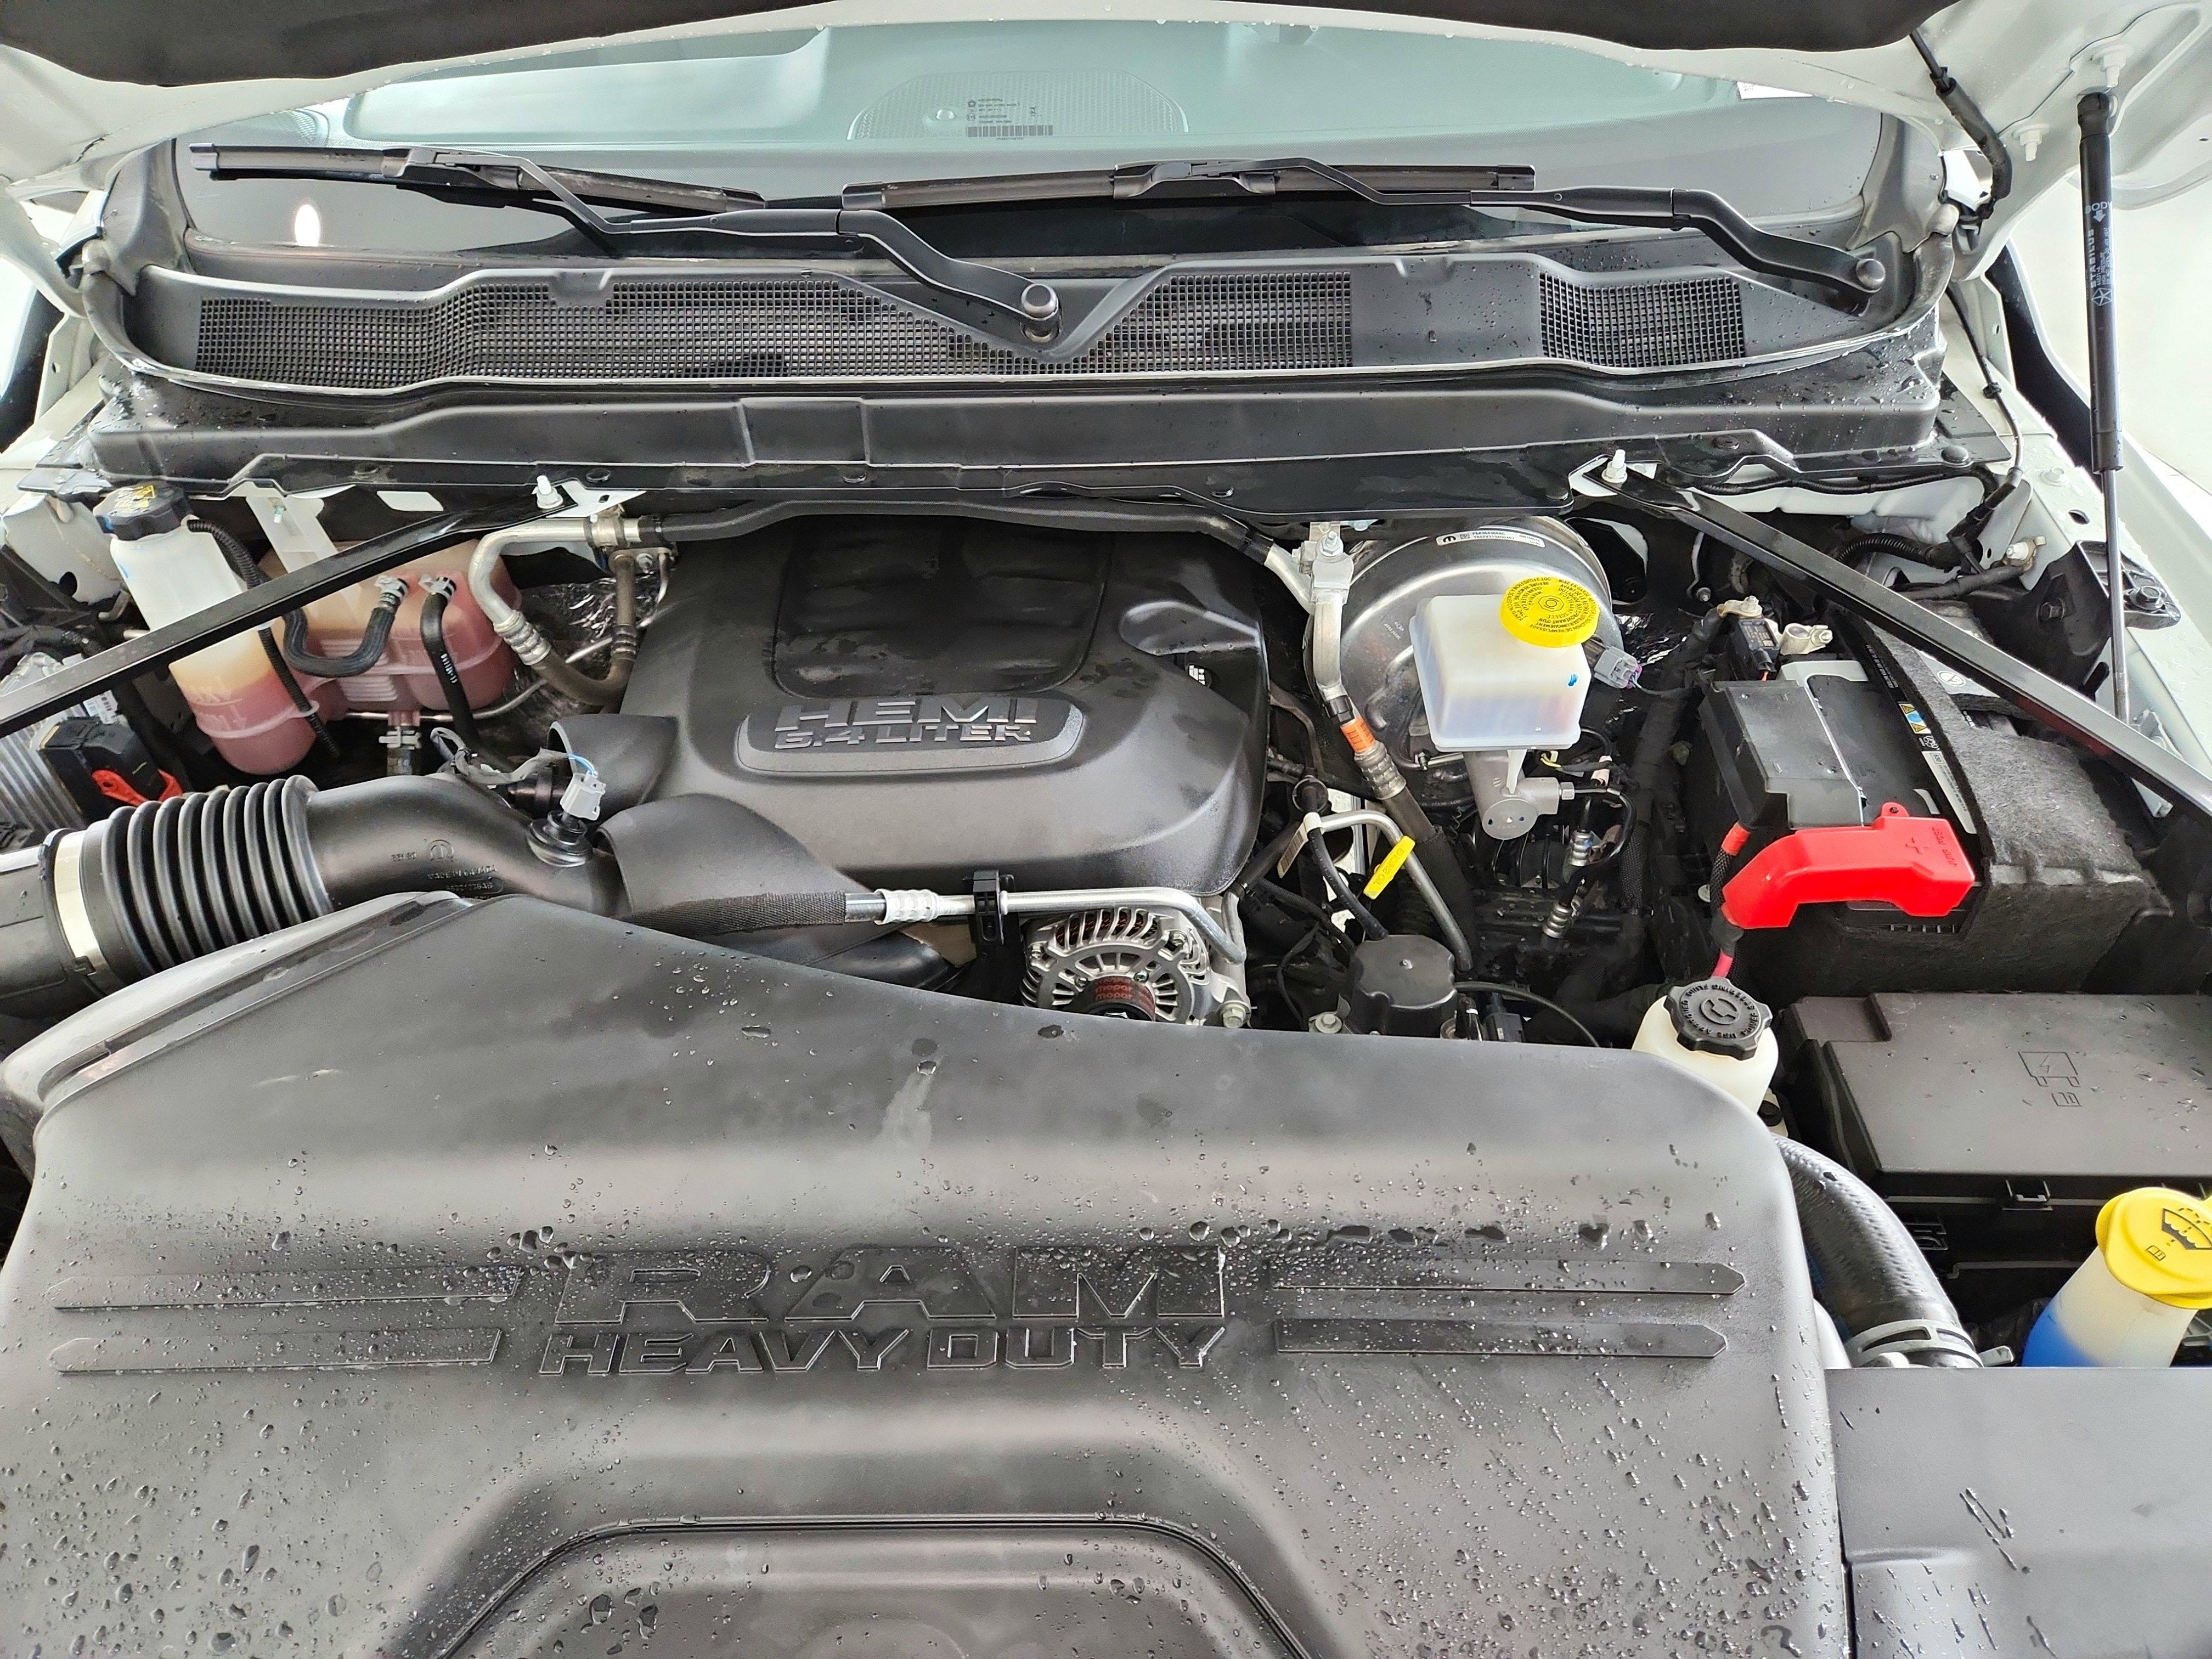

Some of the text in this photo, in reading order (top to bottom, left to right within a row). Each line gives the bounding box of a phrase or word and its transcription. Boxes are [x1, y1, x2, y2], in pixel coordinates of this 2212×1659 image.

[2085, 201, 2112, 213] BODY
[2088, 229, 2096, 288] STABILUS
[775, 698, 1037, 732] HEMI
[876, 724, 1031, 744] LITER
[1373, 847, 1405, 885] ENGINE OIL
[1712, 984, 1755, 1011] STEERING
[554, 1246, 1225, 1323] RAM
[539, 1326, 1227, 1375] HEAVY DUTY
